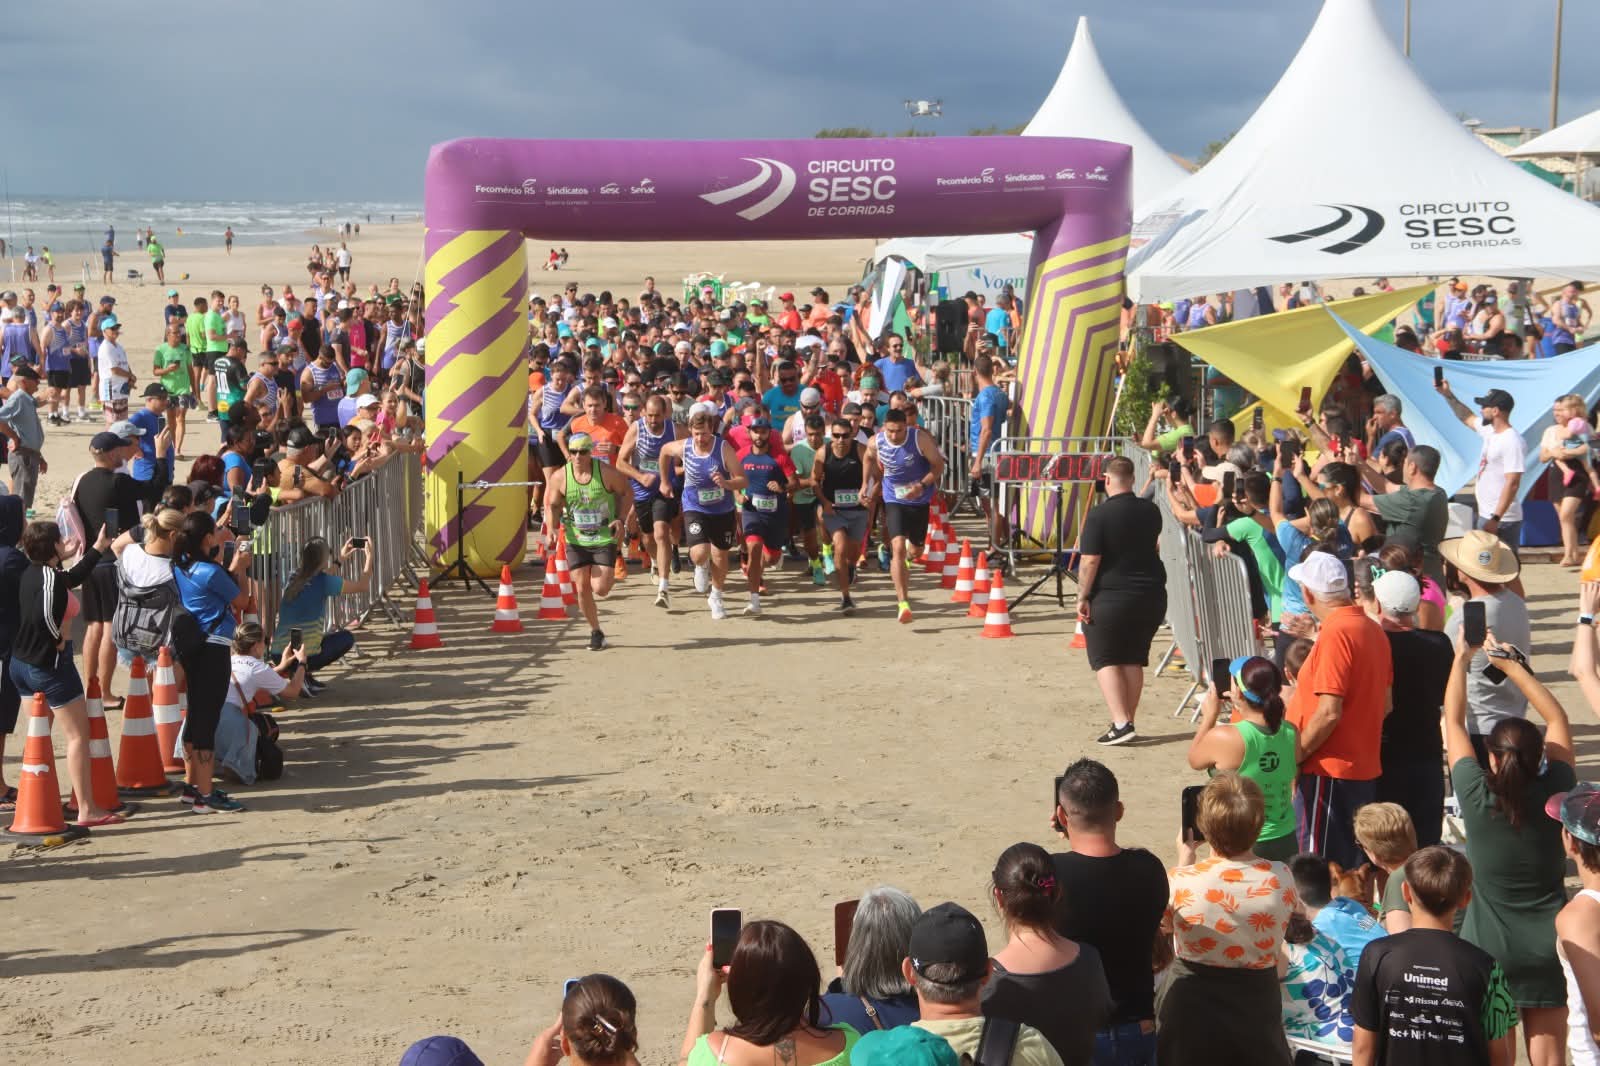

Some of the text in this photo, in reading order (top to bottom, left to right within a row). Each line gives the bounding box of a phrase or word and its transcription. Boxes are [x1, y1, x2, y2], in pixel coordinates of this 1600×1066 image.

[807, 158, 895, 174] CIRCUITO
[1004, 173, 1046, 183] Sindicatos
[475, 185, 522, 195] Fecomércio
[524, 186, 536, 195] RS
[547, 186, 589, 195] Sindicatos
[807, 175, 897, 203] SESC
[807, 204, 896, 217] DE CORRIDAS
[1399, 201, 1510, 216] CIRCUITO
[1404, 215, 1516, 239] SESC
[1410, 237, 1523, 250] DE CORRIDAS
[838, 494, 858, 503] 193
[1403, 972, 1449, 987] Unimed
